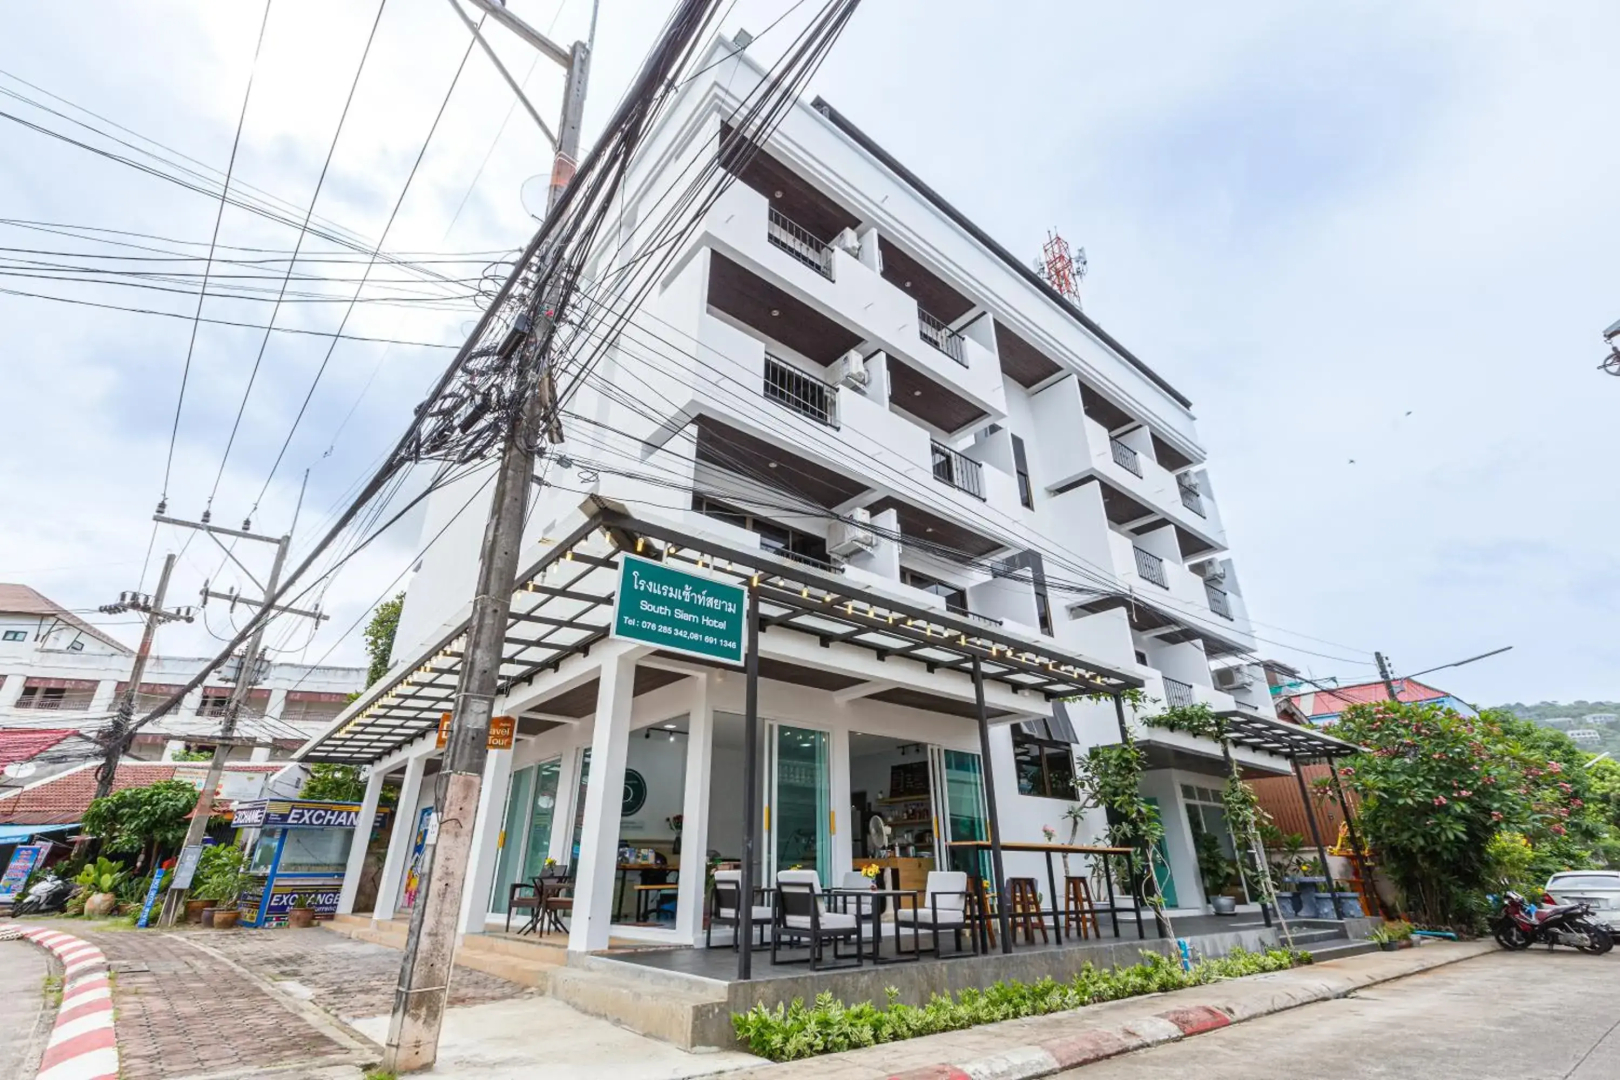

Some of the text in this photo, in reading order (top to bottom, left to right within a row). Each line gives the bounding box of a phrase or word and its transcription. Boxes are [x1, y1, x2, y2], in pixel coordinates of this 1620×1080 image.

[623, 616, 636, 626] Tel
[640, 600, 727, 631] South Siam Hotel
[489, 727, 510, 736] avel
[488, 735, 509, 746] Tour
[287, 809, 361, 826] EXCHAN
[271, 893, 340, 906] EXCANGE
